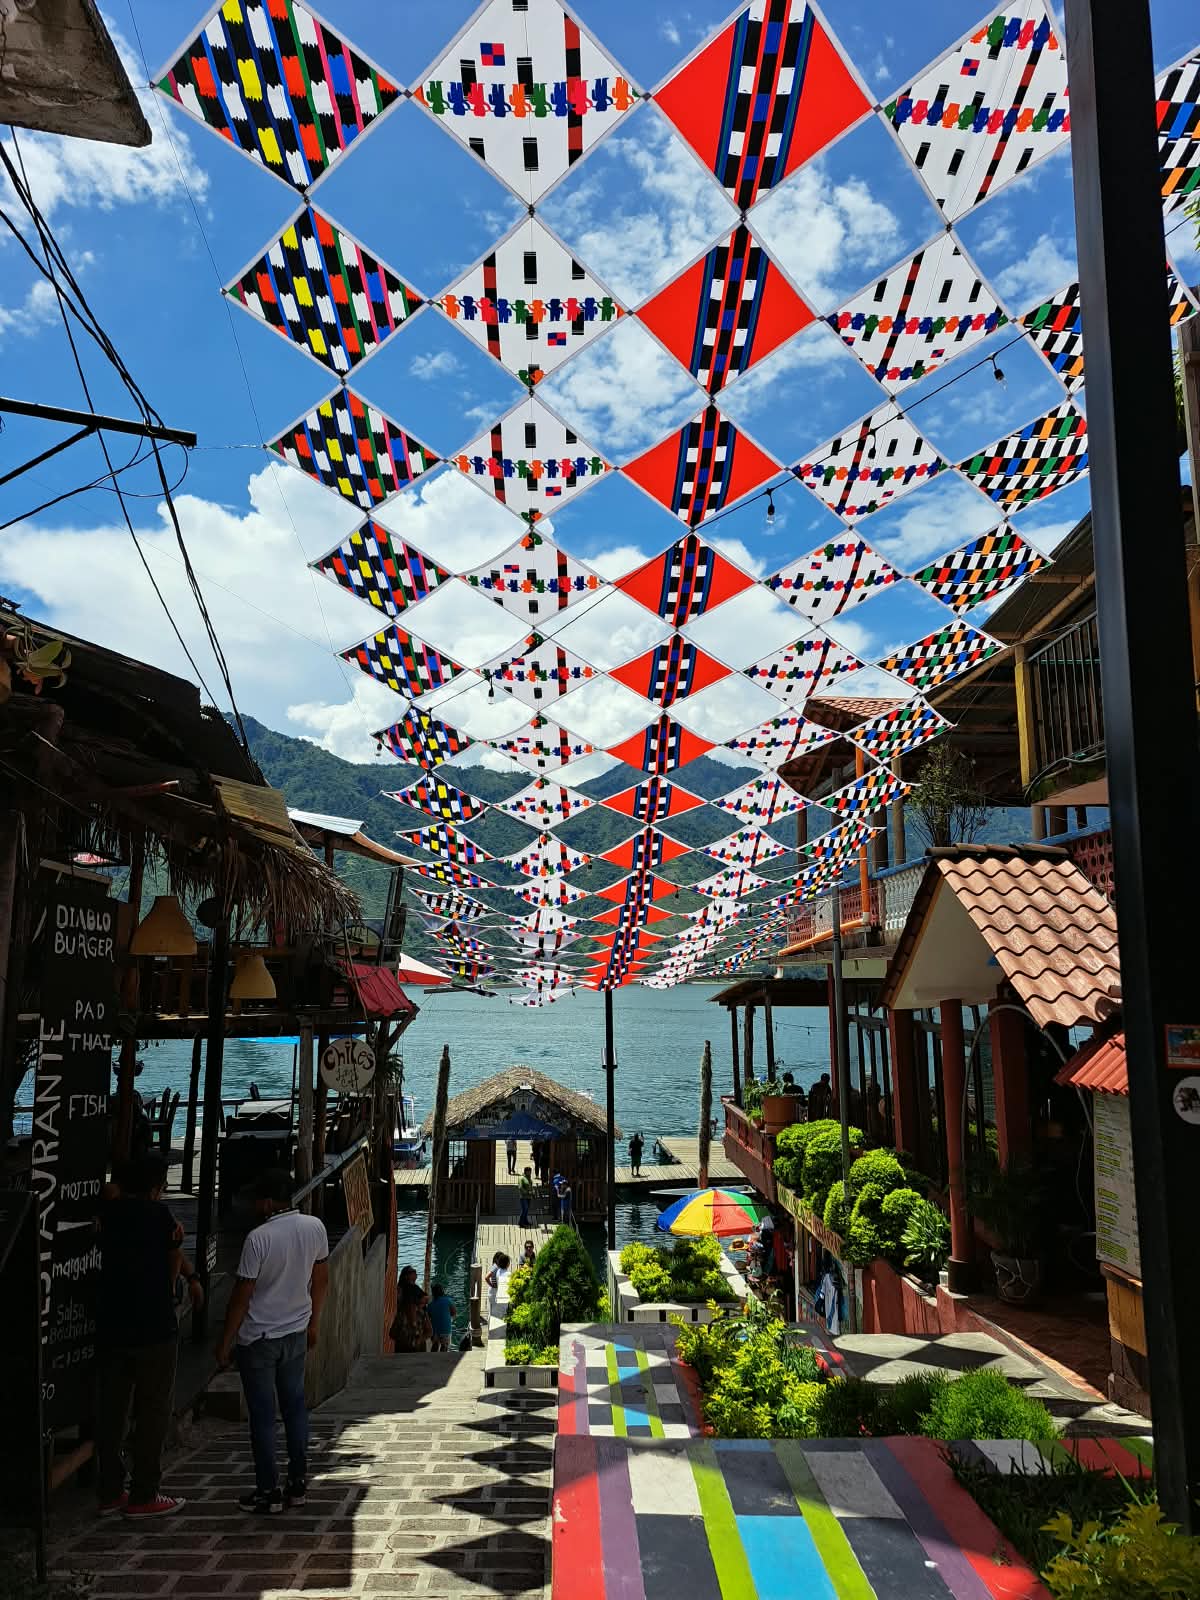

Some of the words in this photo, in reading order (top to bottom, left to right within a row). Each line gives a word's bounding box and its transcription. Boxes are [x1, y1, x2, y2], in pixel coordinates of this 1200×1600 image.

[56, 904, 112, 933] DIABLO
[54, 931, 115, 962] BURGER
[74, 999, 105, 1021] PAD
[68, 1033, 112, 1053] THAI
[68, 1094, 108, 1121] FISH
[60, 1178, 102, 1202] MOJITO
